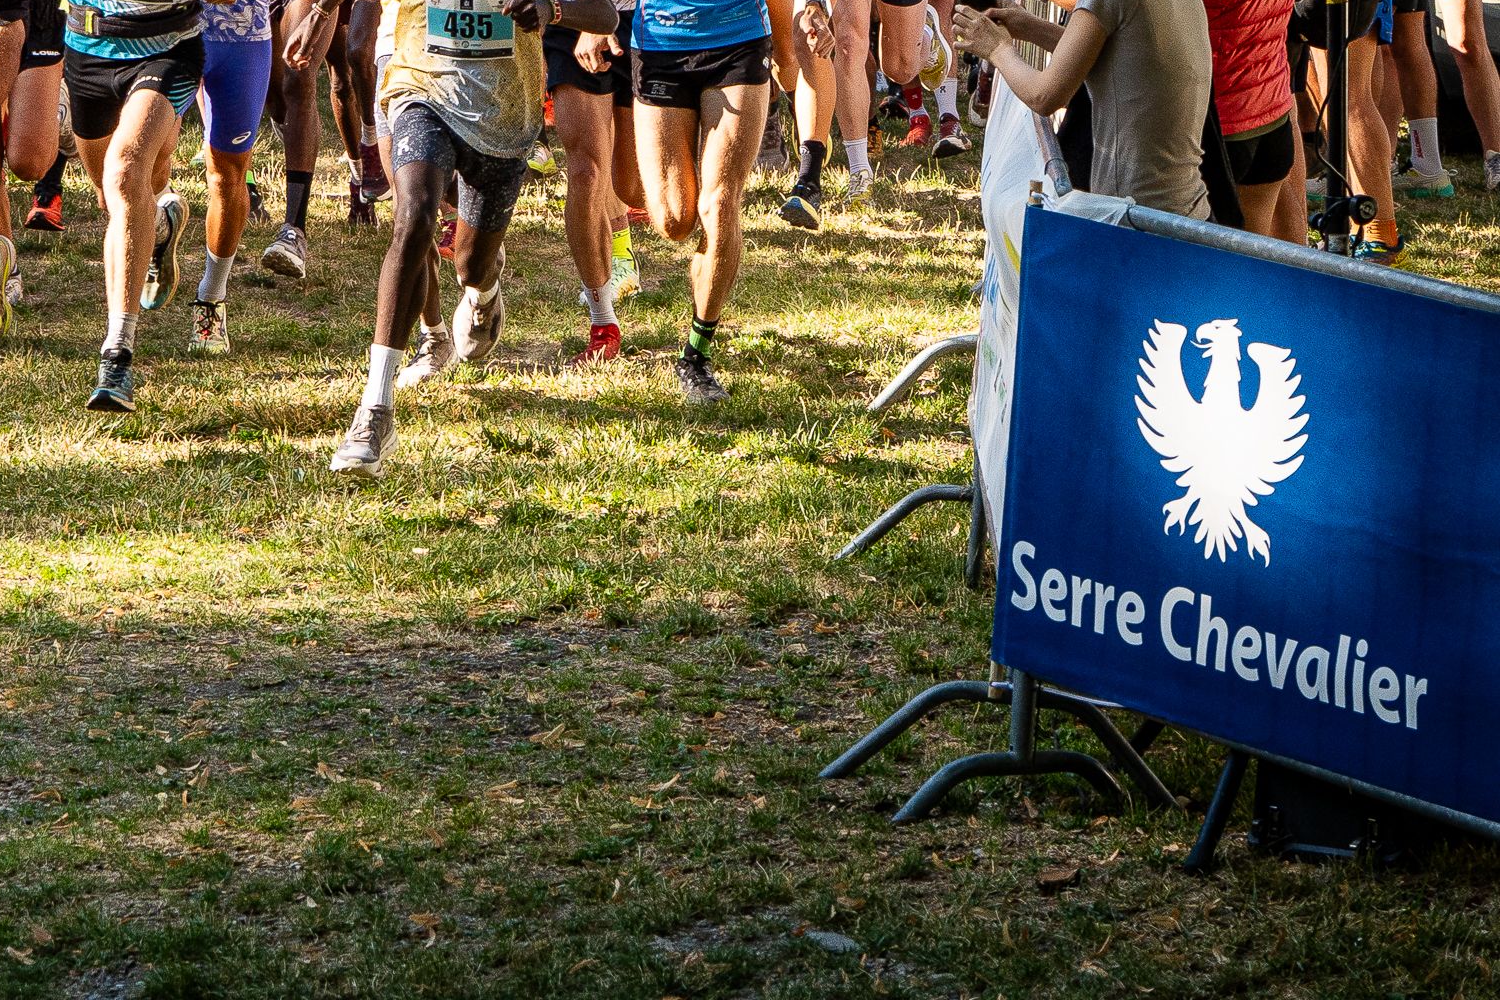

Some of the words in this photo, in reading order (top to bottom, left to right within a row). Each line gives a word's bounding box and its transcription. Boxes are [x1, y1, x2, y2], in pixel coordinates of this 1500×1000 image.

[444, 12, 493, 40] 435
[1010, 540, 1145, 646] Serre
[1158, 585, 1428, 731] Chevalier
